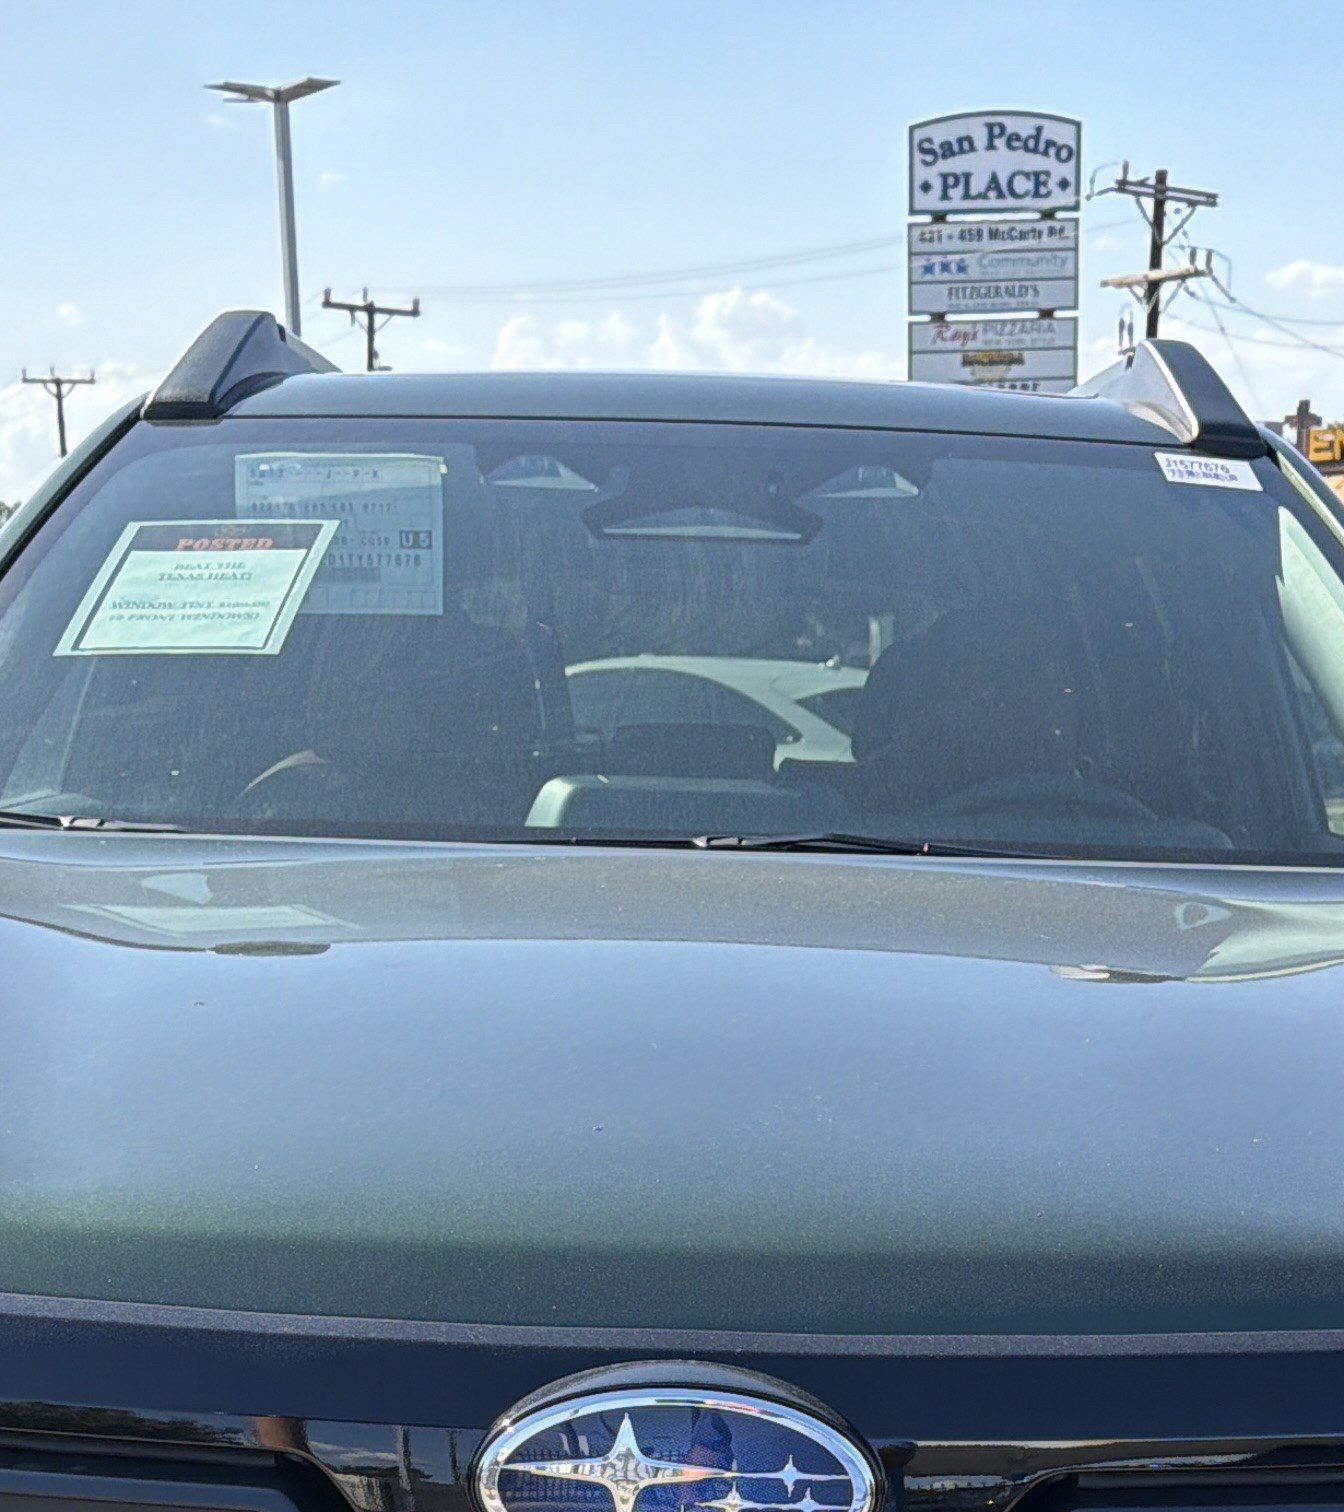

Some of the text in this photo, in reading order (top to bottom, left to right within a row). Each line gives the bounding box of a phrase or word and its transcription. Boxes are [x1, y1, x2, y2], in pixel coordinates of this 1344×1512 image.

[917, 121, 1074, 167] San Pedro
[938, 170, 1052, 201] PLACE
